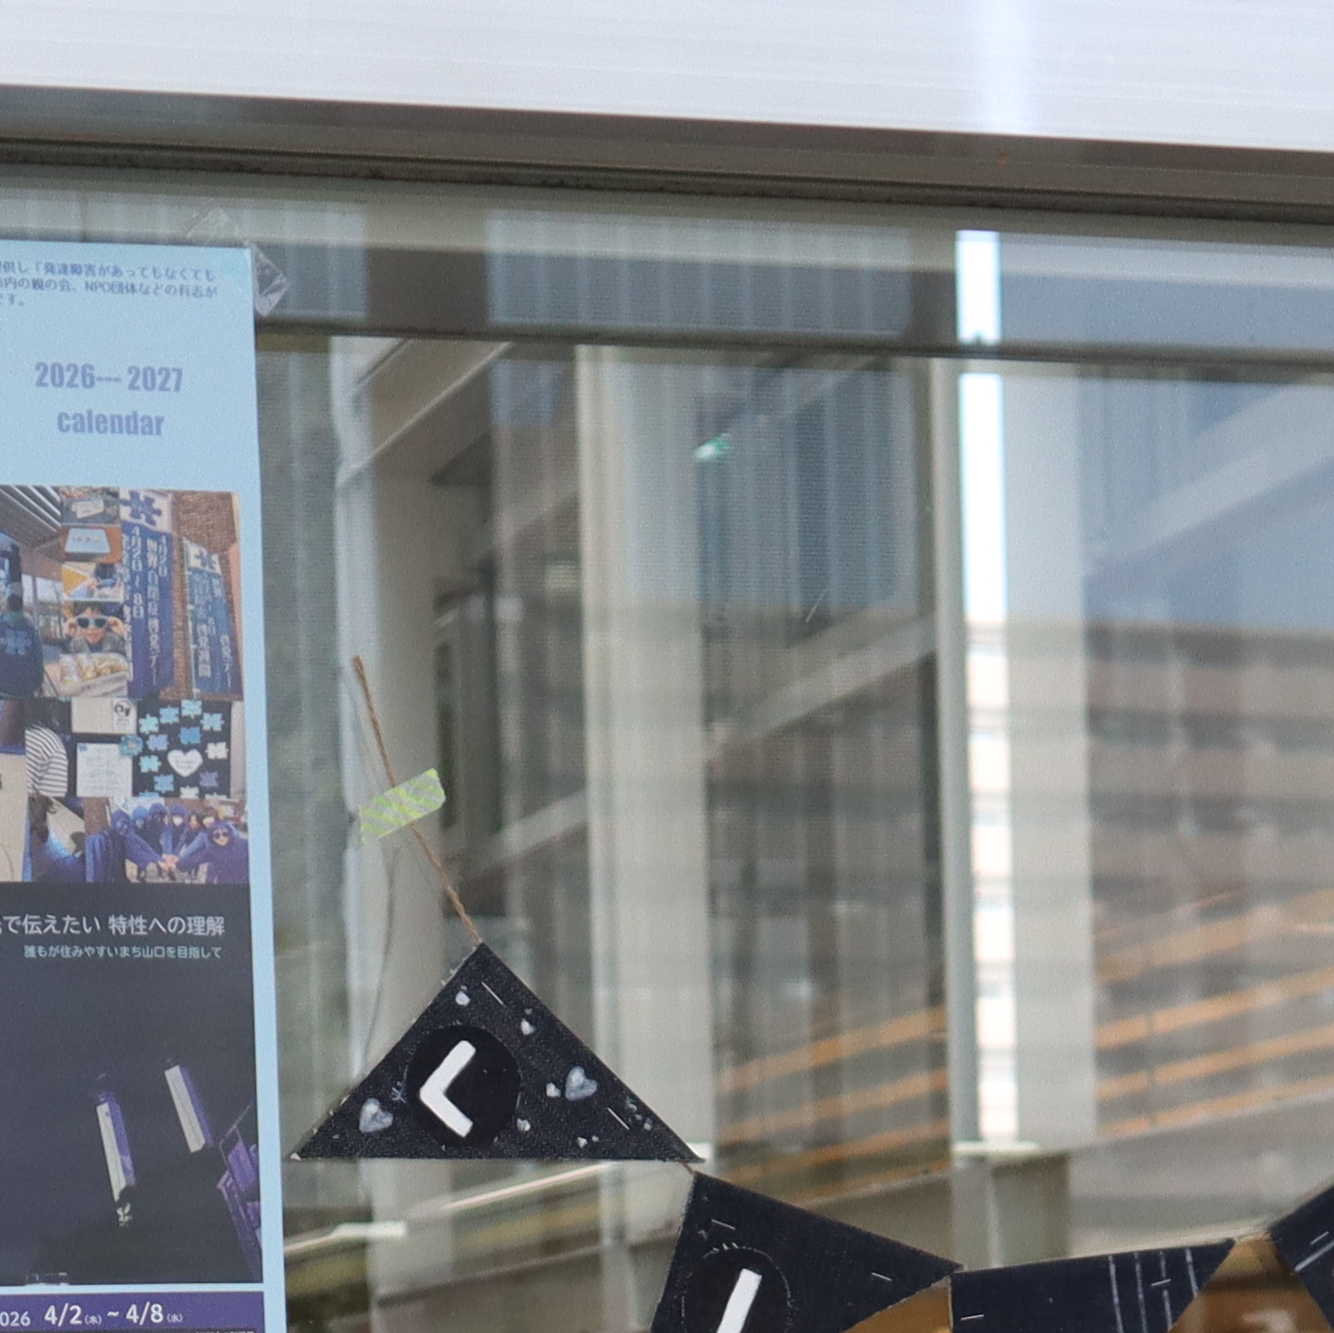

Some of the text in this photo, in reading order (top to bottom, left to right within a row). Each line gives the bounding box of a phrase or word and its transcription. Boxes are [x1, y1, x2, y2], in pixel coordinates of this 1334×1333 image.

[56, 407, 165, 438] calendar
[109, 914, 226, 938] 特性への理解
[419, 1039, 476, 1138] L
